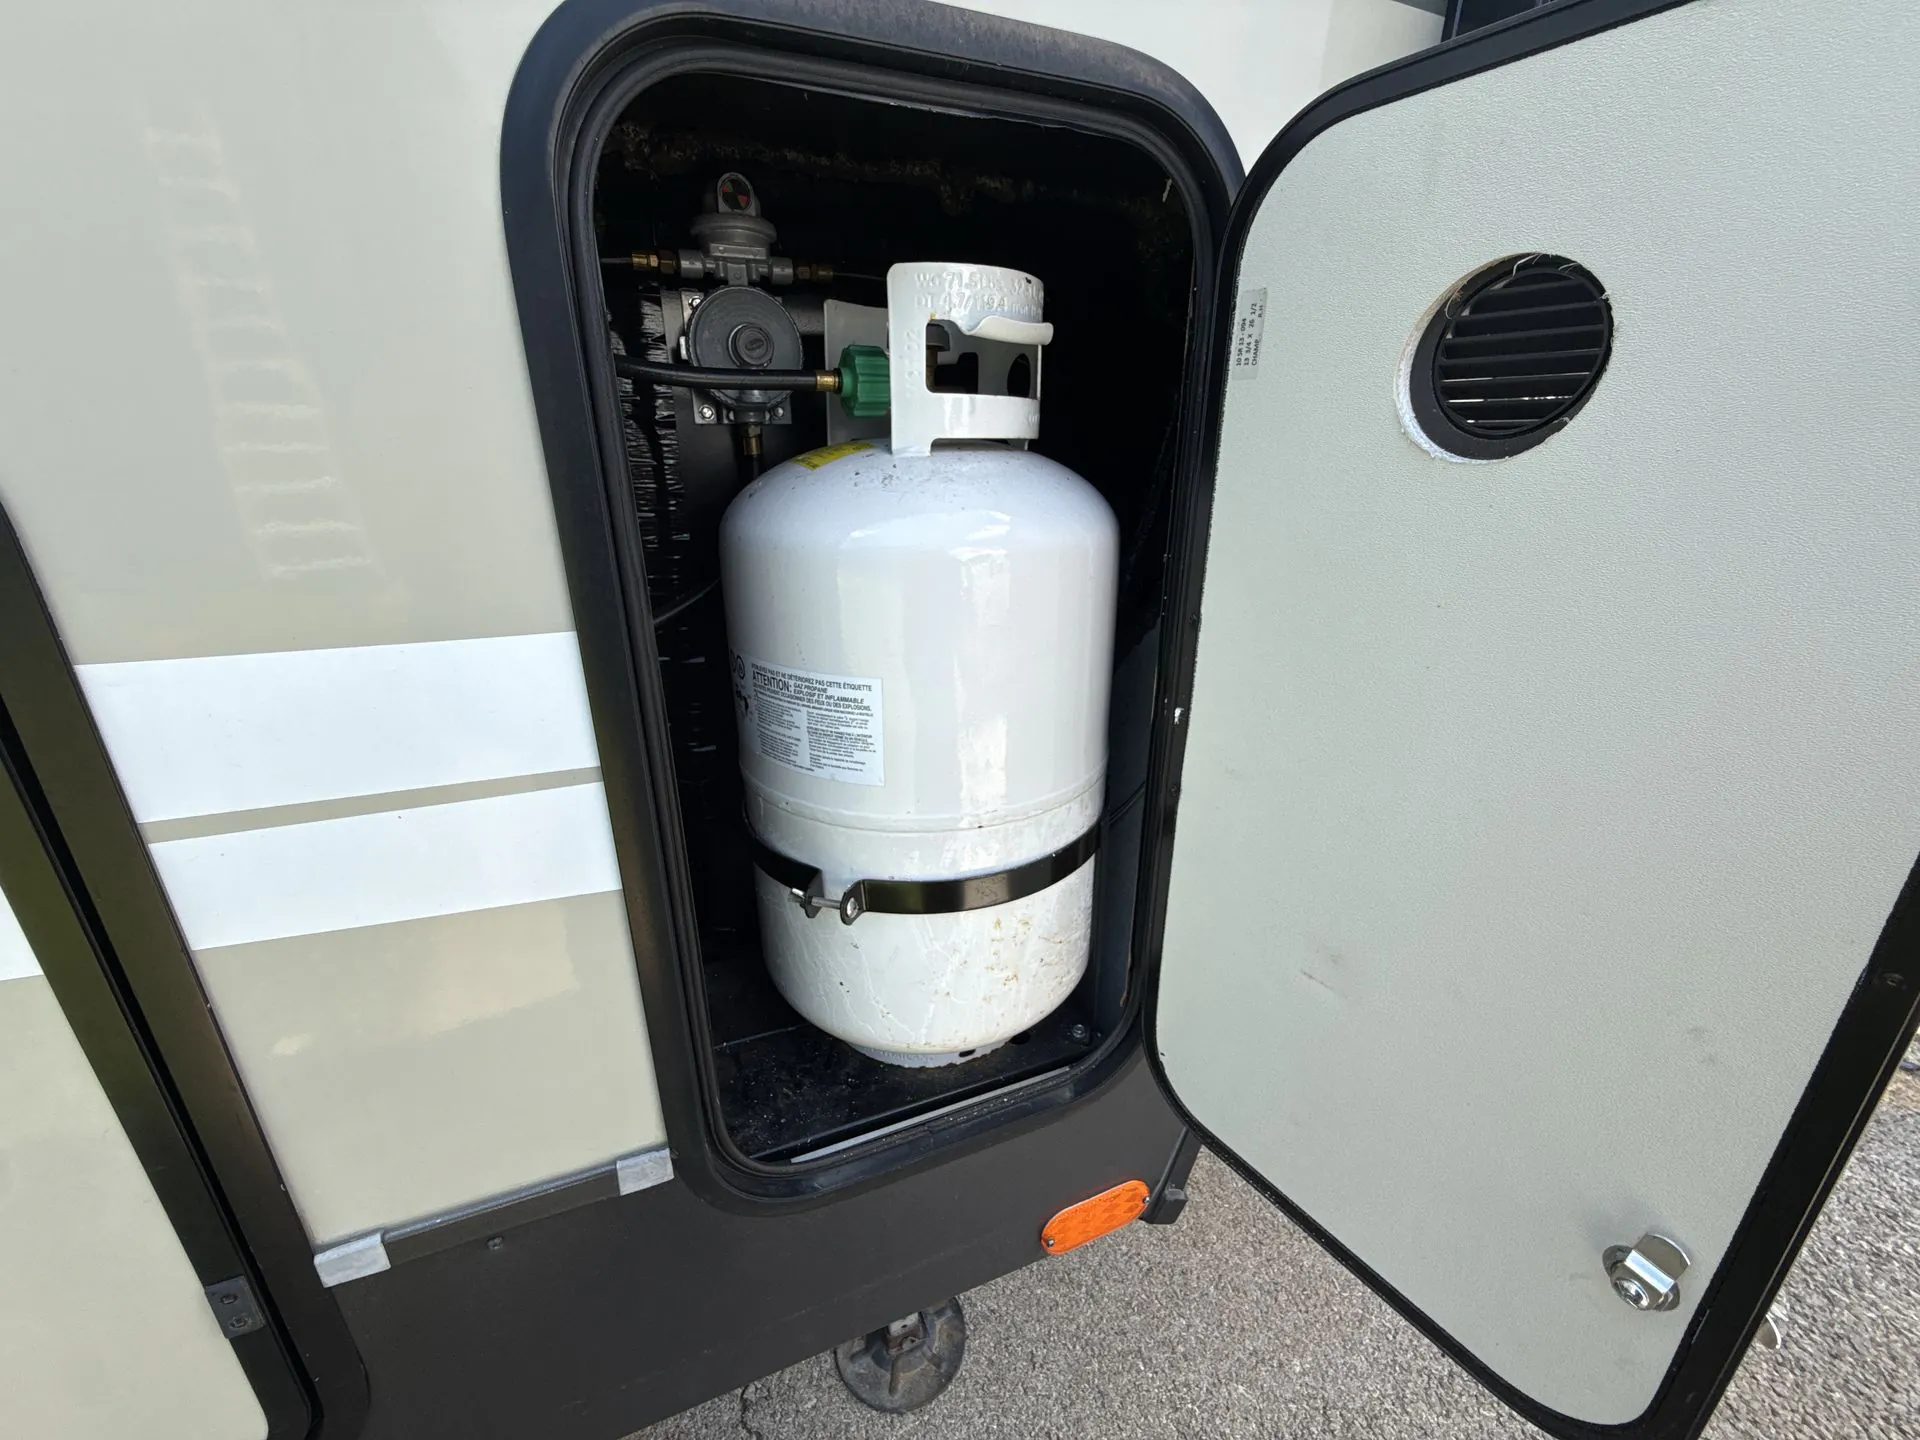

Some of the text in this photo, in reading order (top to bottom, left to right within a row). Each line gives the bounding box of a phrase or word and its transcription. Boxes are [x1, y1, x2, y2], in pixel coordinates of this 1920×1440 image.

[793, 682, 828, 694] GAZ PROPANE
[815, 679, 826, 687] PAS
[826, 680, 842, 689] CETTE
[843, 681, 872, 692] ÉTIQUETTE
[793, 689, 817, 698] EXPLOSIF
[824, 694, 865, 705] INFLAMMABLE
